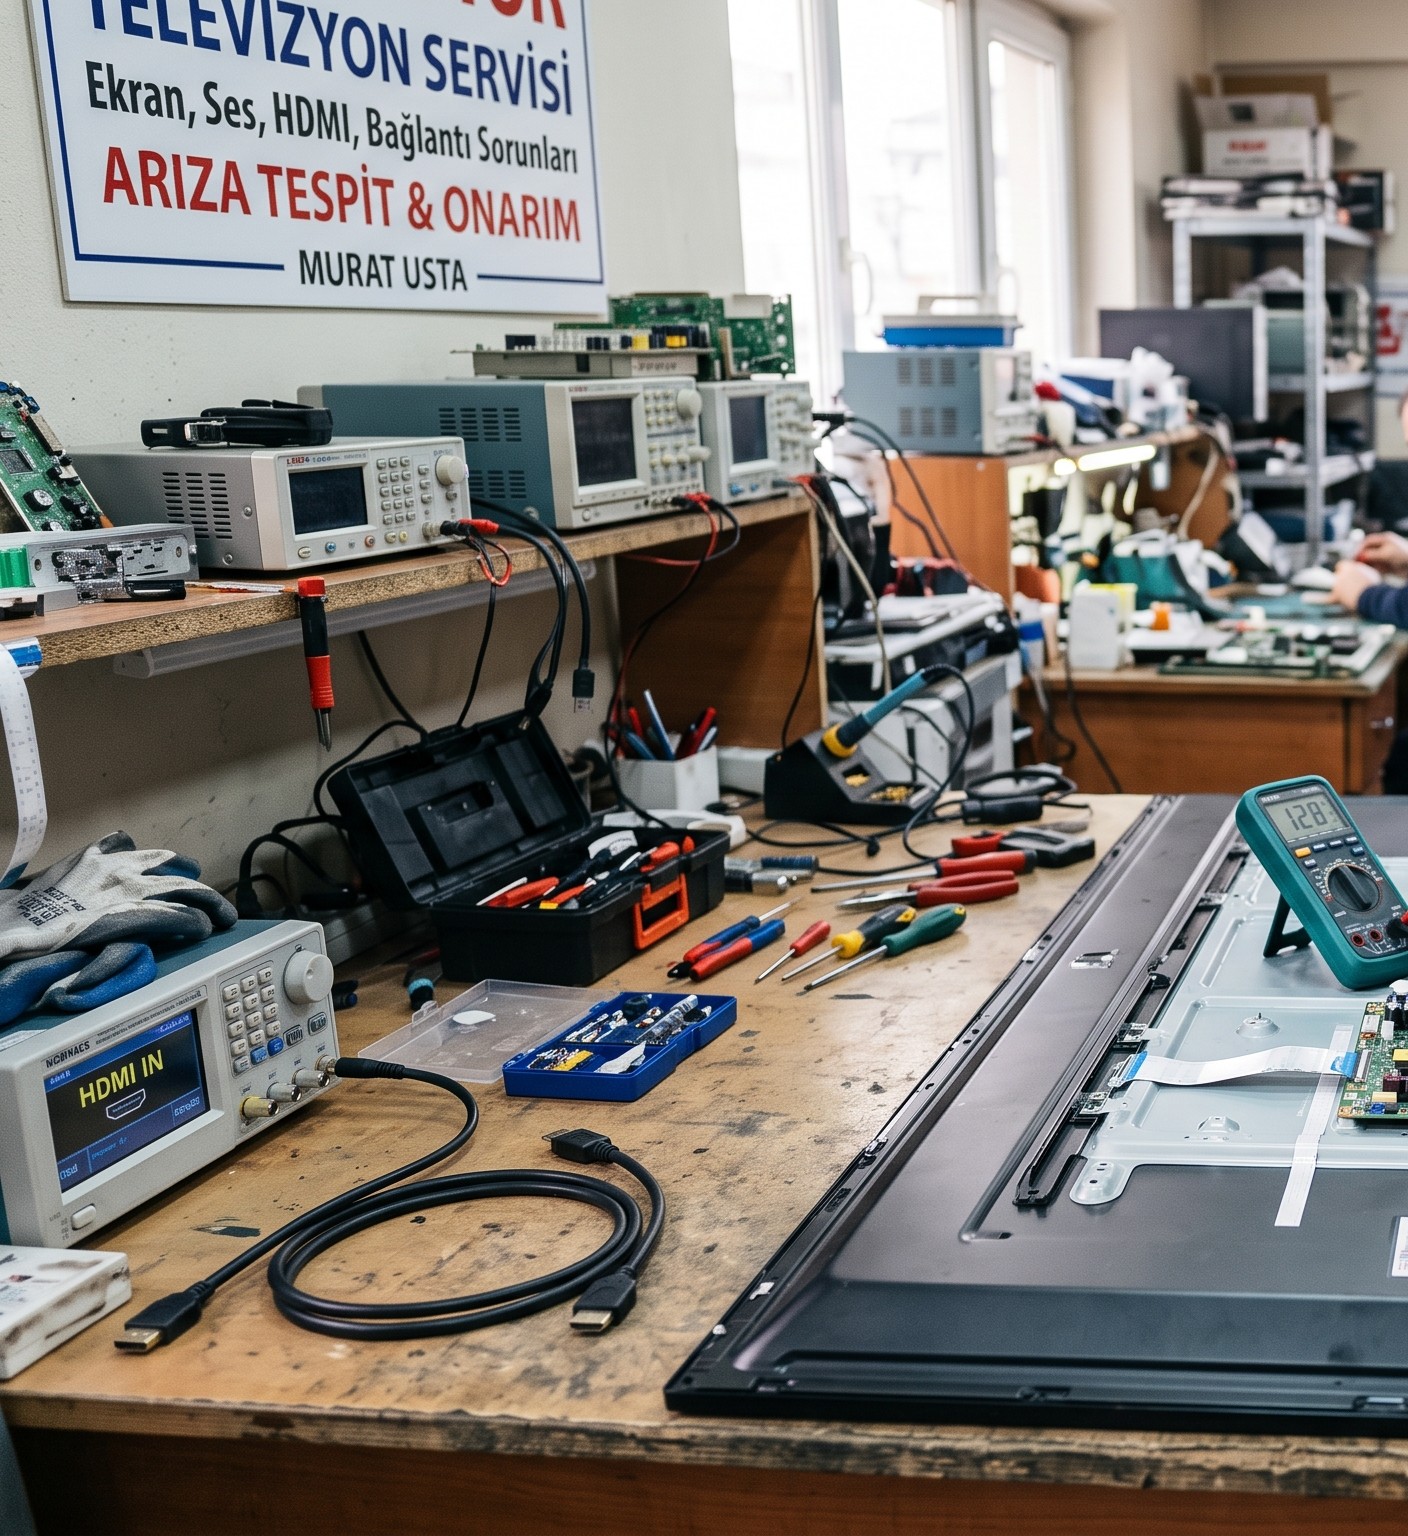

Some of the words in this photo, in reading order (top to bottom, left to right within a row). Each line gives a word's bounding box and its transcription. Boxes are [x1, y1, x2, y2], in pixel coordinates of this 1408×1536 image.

[423, 34, 572, 116] SERVİSİ
[86, 60, 196, 129] Ekran,
[203, 81, 266, 139] Ses,
[273, 91, 359, 151] HDMI,
[366, 107, 471, 162] Bağlantı
[478, 126, 577, 174] Sorunları
[104, 146, 252, 216] ARIZA
[257, 163, 394, 227] TESPİT
[408, 182, 434, 231] &
[444, 186, 580, 242] ONARIM
[299, 250, 395, 288] MURAT
[403, 257, 468, 291] USTA
[79, 1063, 136, 1108] HDMI
[141, 1049, 164, 1078] IN
